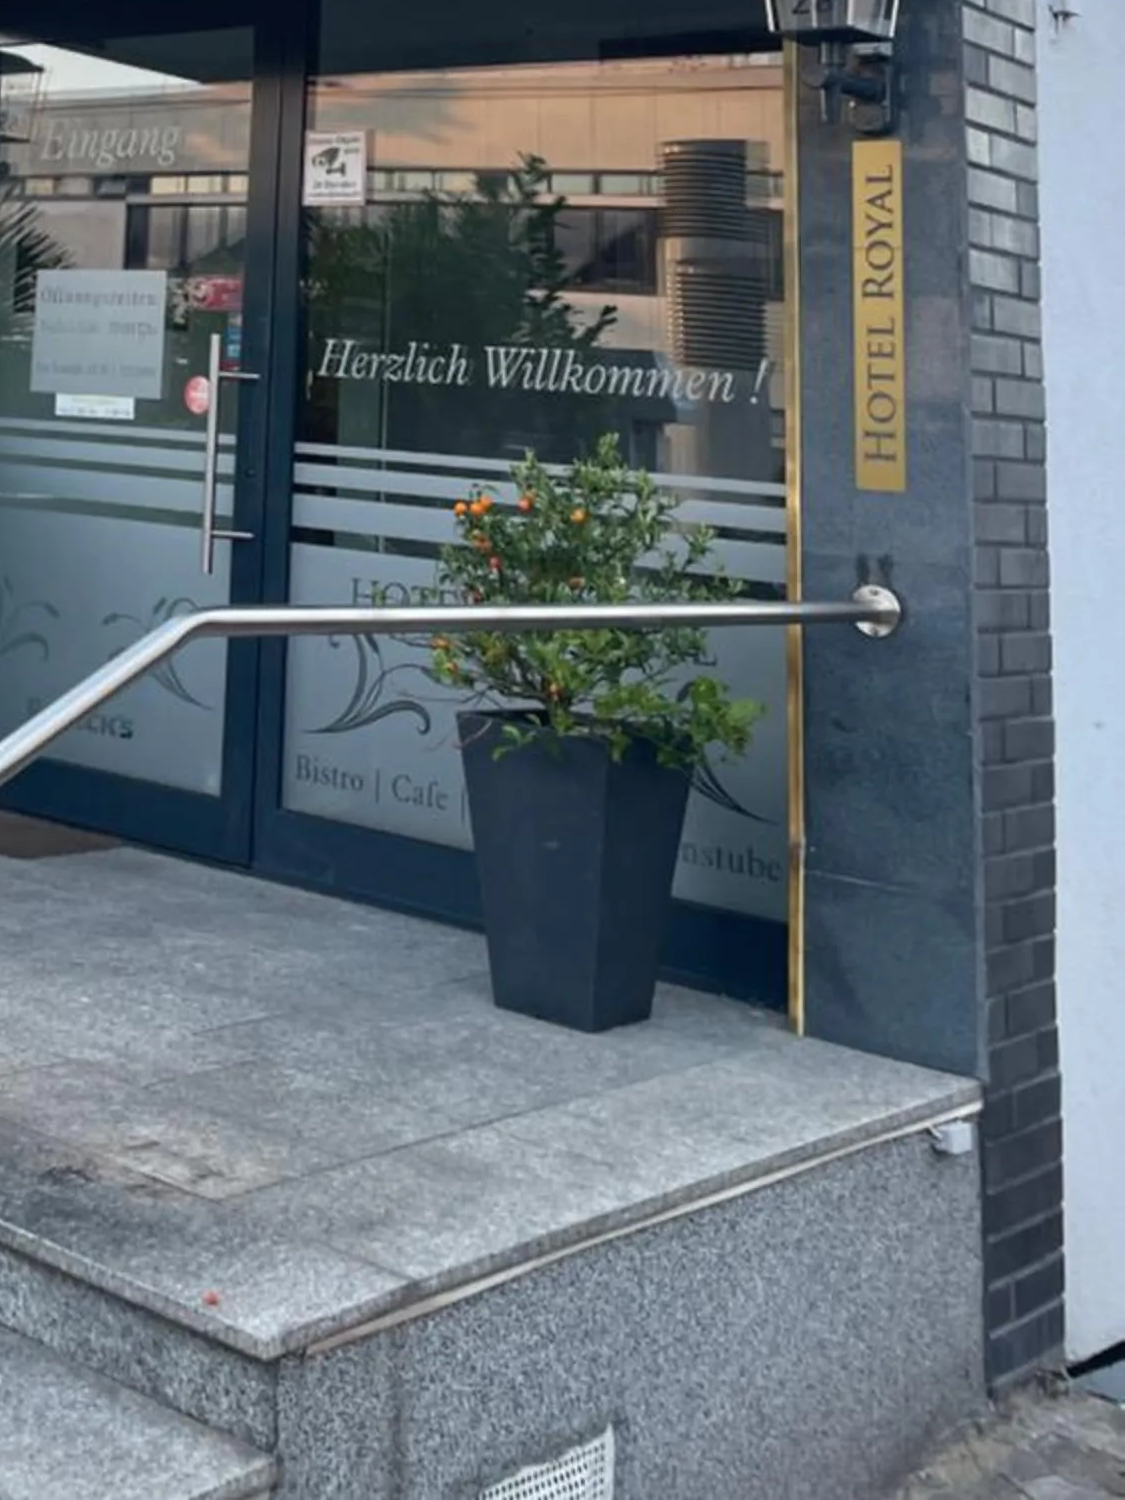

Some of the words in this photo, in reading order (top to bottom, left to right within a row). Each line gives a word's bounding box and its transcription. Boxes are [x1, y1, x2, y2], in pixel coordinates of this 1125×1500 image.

[39, 118, 182, 169] Eingang
[861, 162, 894, 299] ROYAL
[319, 337, 470, 387] Herzlich
[484, 343, 736, 403] Willkommen
[863, 315, 897, 463] HOTEL
[296, 754, 366, 793] Bistro
[391, 774, 450, 811] Cafe
[681, 842, 781, 884] nstube
